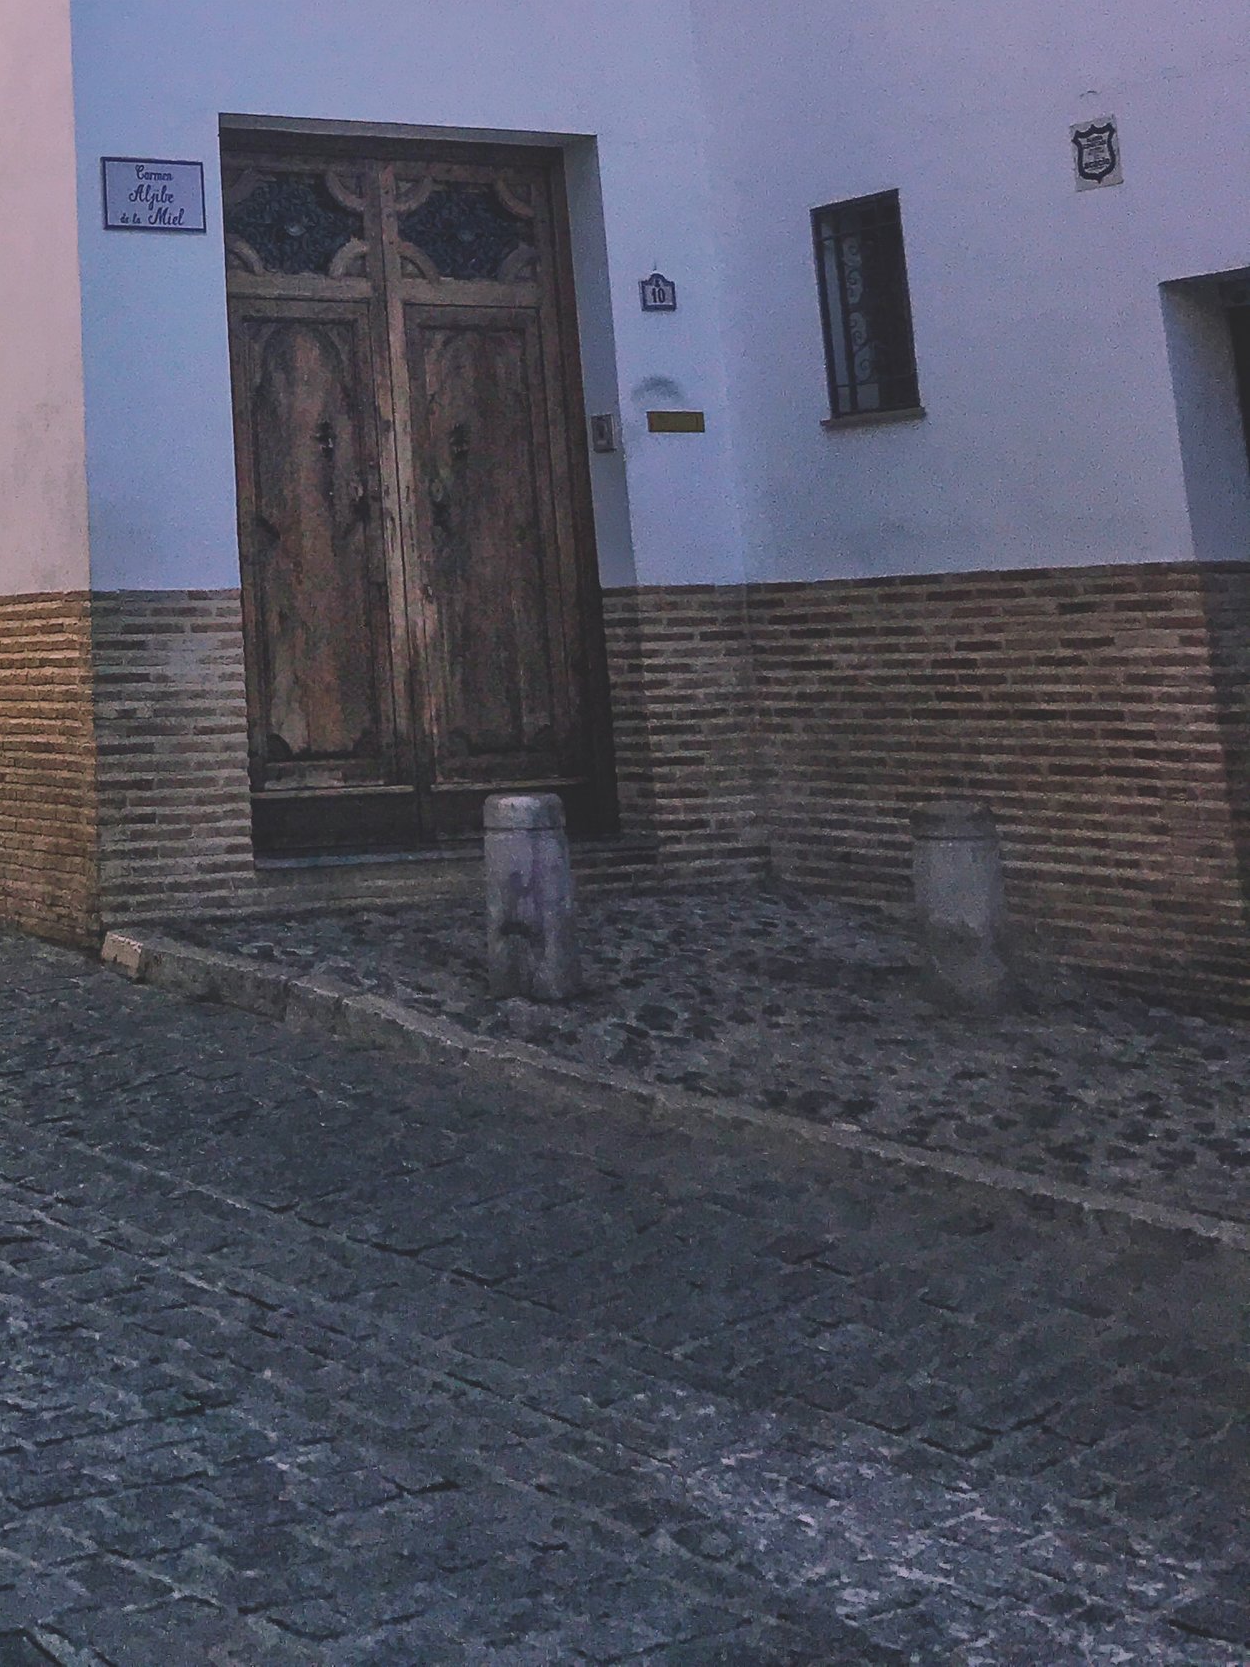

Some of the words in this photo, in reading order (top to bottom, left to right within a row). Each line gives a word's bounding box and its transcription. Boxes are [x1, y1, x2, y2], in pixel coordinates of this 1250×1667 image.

[135, 165, 173, 181] Carmen
[129, 184, 174, 210] Aljibe
[148, 207, 184, 225] Miel
[652, 288, 665, 303] 10
